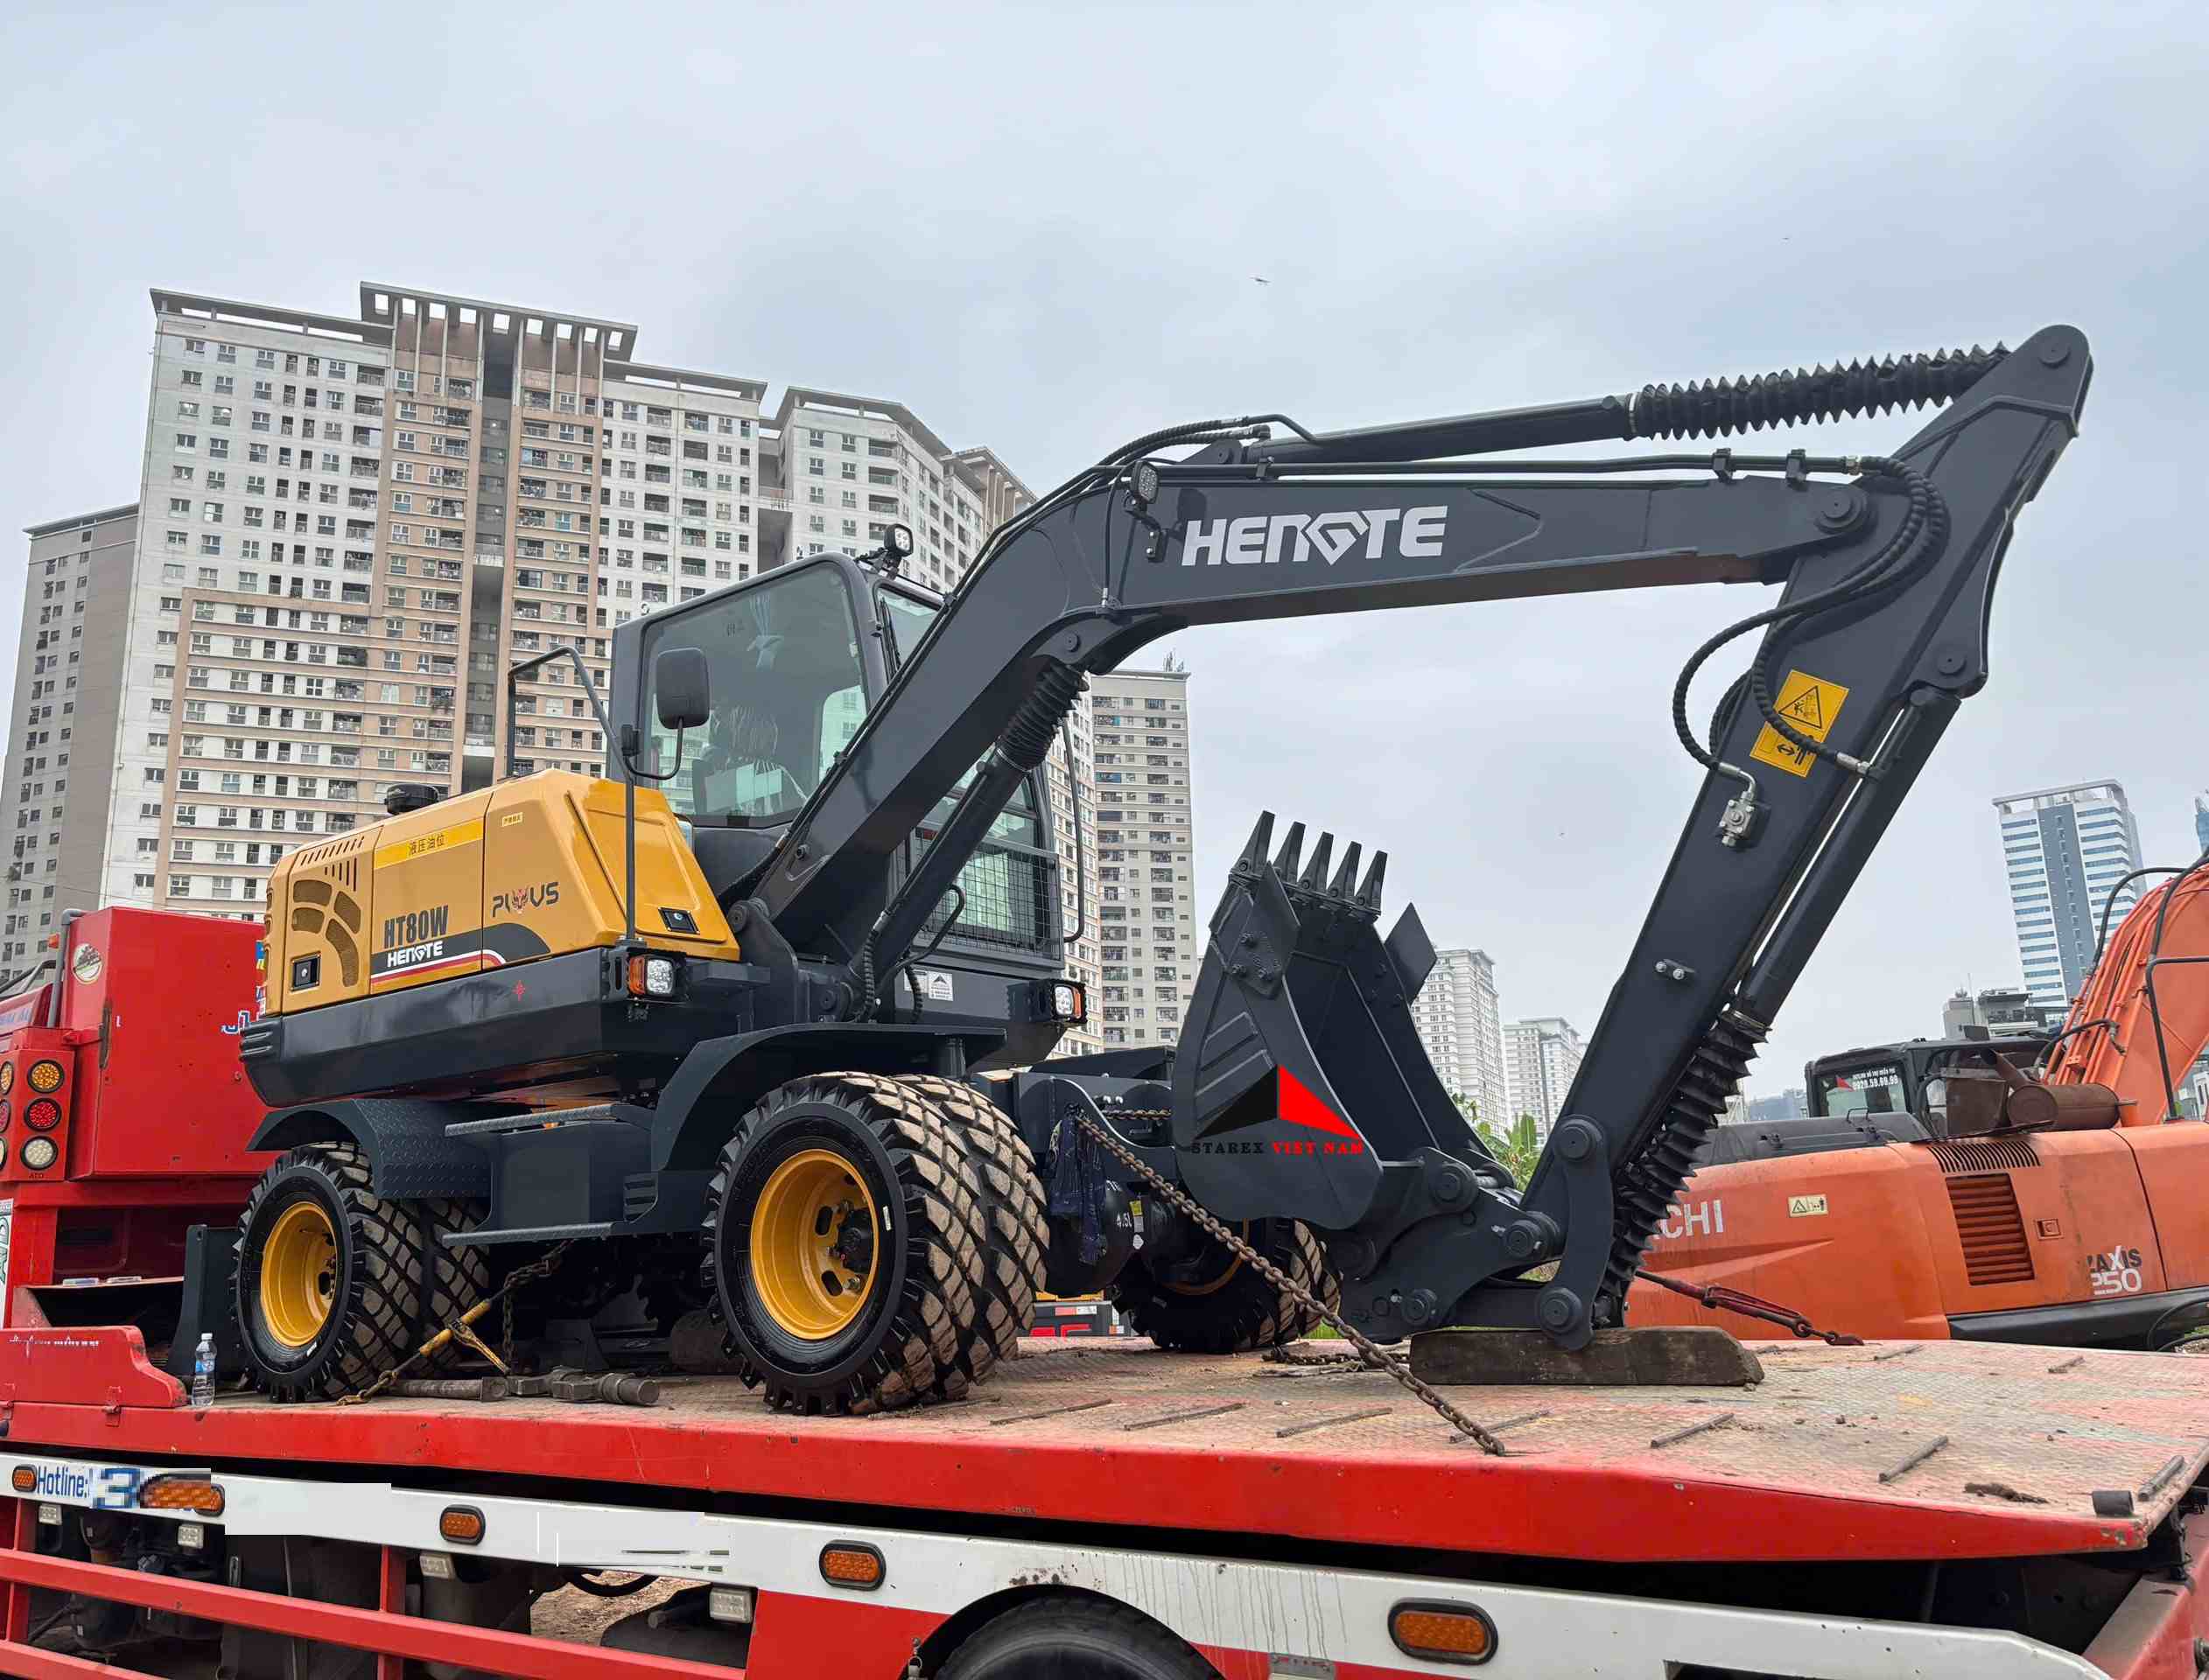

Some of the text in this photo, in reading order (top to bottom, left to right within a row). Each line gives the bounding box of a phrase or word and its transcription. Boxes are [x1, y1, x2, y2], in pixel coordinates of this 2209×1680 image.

[1182, 505, 1448, 566] HENGTE
[384, 905, 449, 948] HT80W
[387, 940, 444, 967] HENGTE
[1652, 1199, 1723, 1239] CHI
